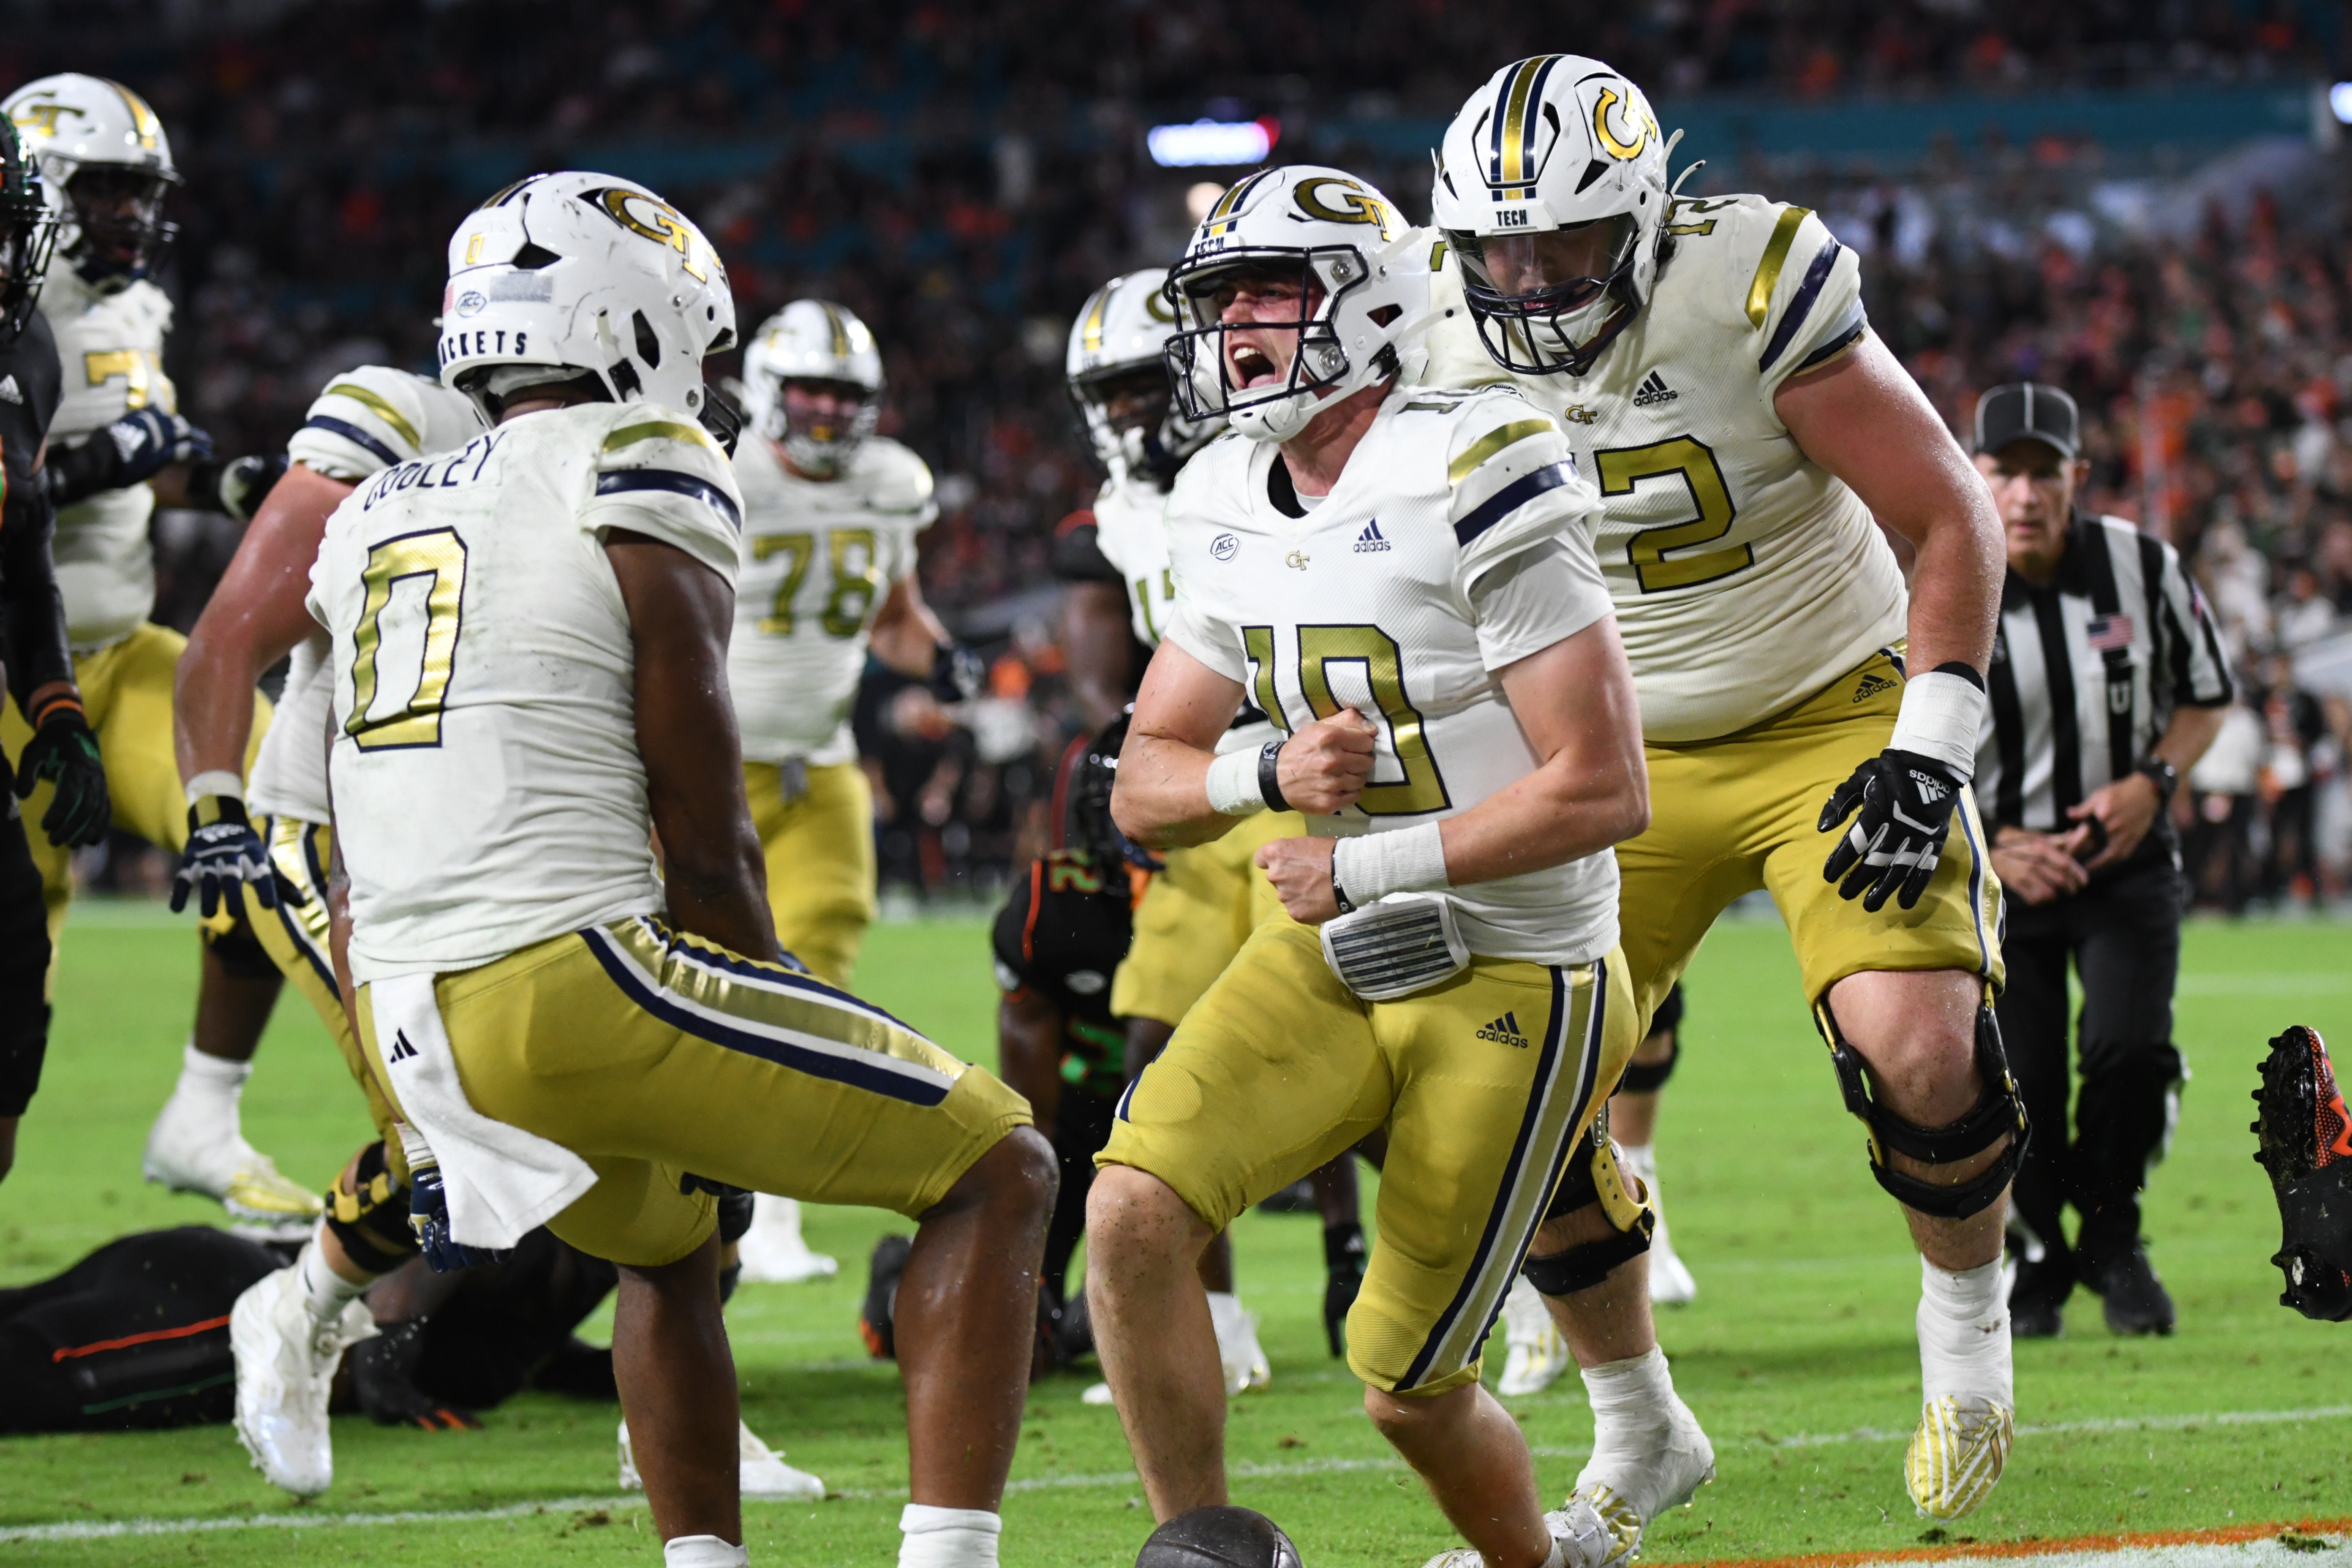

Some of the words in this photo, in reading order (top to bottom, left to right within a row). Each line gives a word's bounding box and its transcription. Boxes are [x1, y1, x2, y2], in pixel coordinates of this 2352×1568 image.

[1293, 177, 1402, 242] GT
[1496, 209, 1527, 226] TECH
[603, 187, 723, 285] GT
[466, 232, 485, 264] 0
[460, 296, 480, 307] ACC
[1633, 390, 1678, 407] adidas
[1565, 405, 1598, 425] GT
[1215, 538, 1234, 553] ACC
[1353, 539, 1391, 553] adidas
[1286, 550, 1309, 571] GT
[344, 525, 468, 754] 0
[1852, 679, 1898, 703] adidas
[2110, 681, 2130, 715] U
[1240, 623, 1453, 817] 10
[1909, 769, 1951, 794] adidas
[1476, 1029, 1528, 1048] adidas
